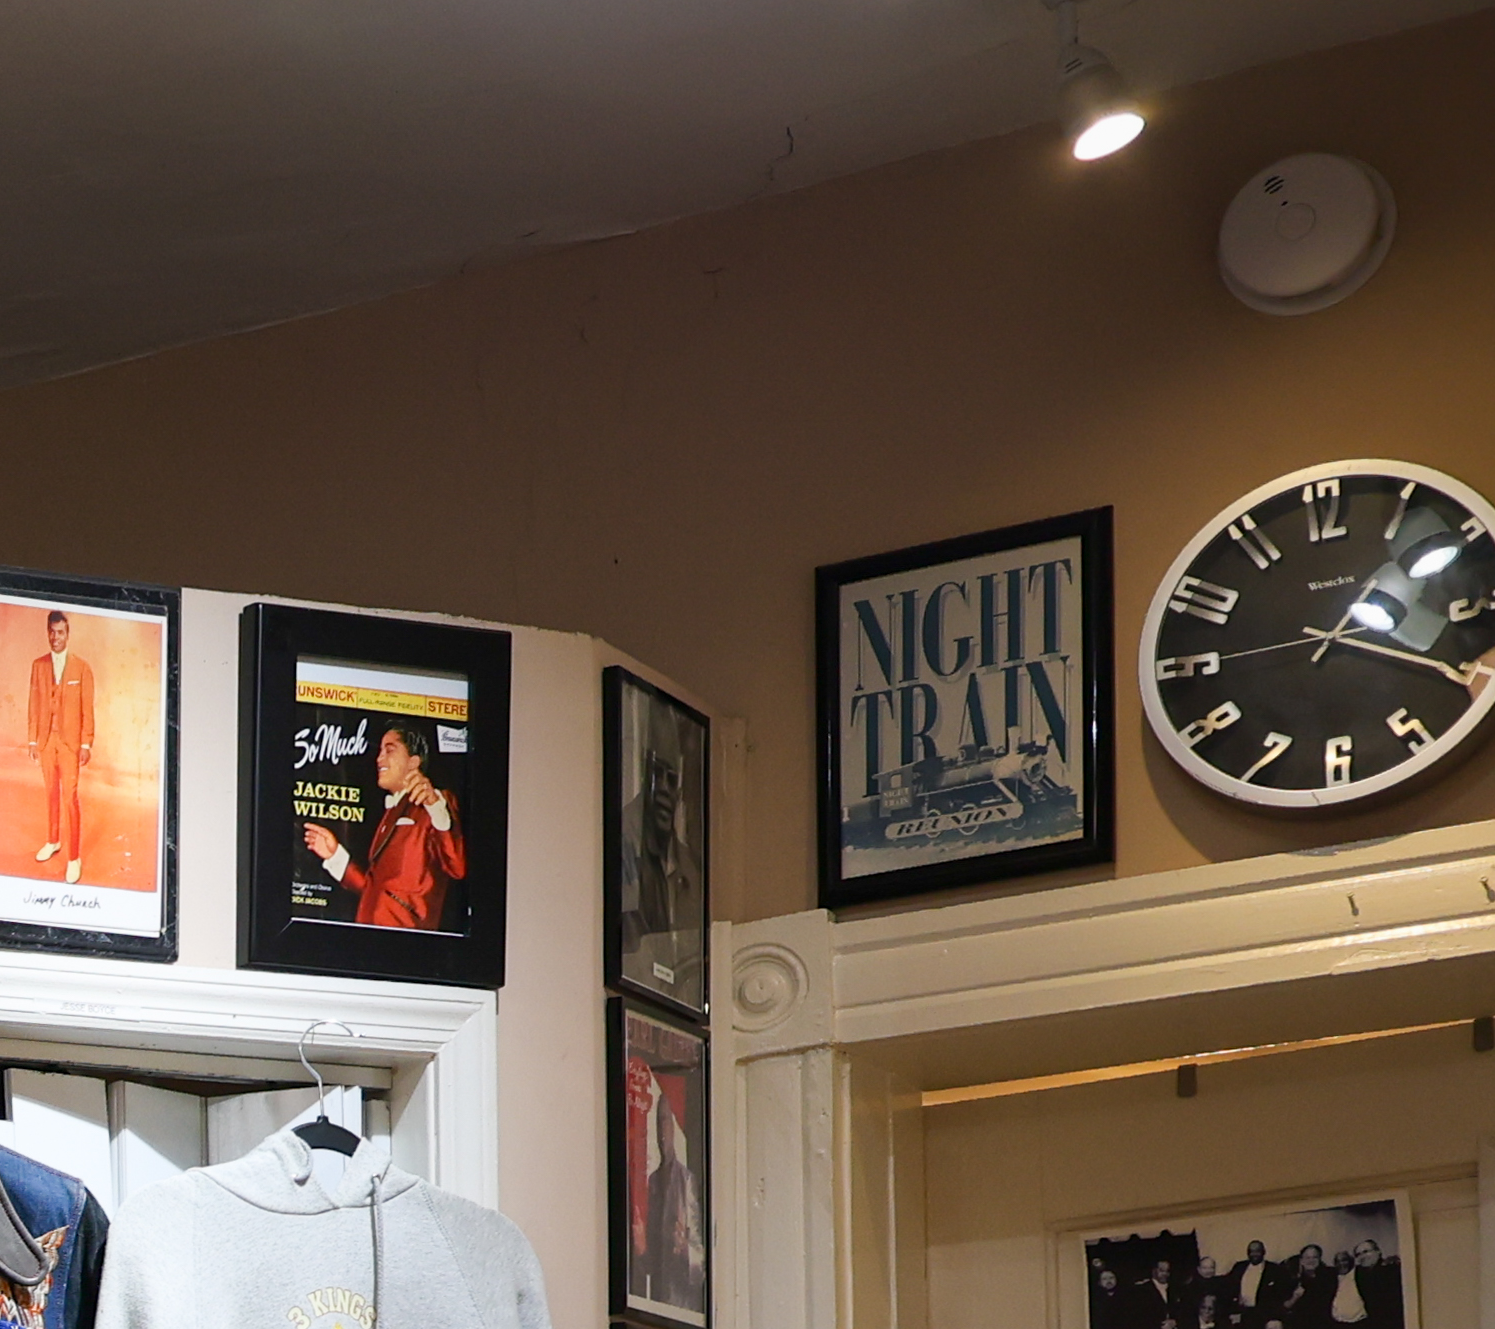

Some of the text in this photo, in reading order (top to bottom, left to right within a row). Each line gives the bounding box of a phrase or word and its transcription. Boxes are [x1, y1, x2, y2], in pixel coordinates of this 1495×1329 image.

[1301, 477, 1348, 543] 12
[1383, 481, 1417, 540] 1
[1227, 514, 1283, 570] 11
[1168, 574, 1240, 626] 10
[1307, 571, 1358, 593] Westclox
[852, 558, 1074, 691] NIGHT
[1156, 650, 1221, 681] 9
[294, 718, 369, 769] So Much
[850, 658, 1069, 798] TRAIN
[1180, 700, 1244, 748] 8
[1386, 707, 1437, 755] 5
[1240, 730, 1293, 782] 7
[1324, 735, 1353, 789] 6
[294, 780, 361, 803] JACKIE
[294, 799, 365, 823] WILSON
[895, 803, 1015, 838] REUNION
